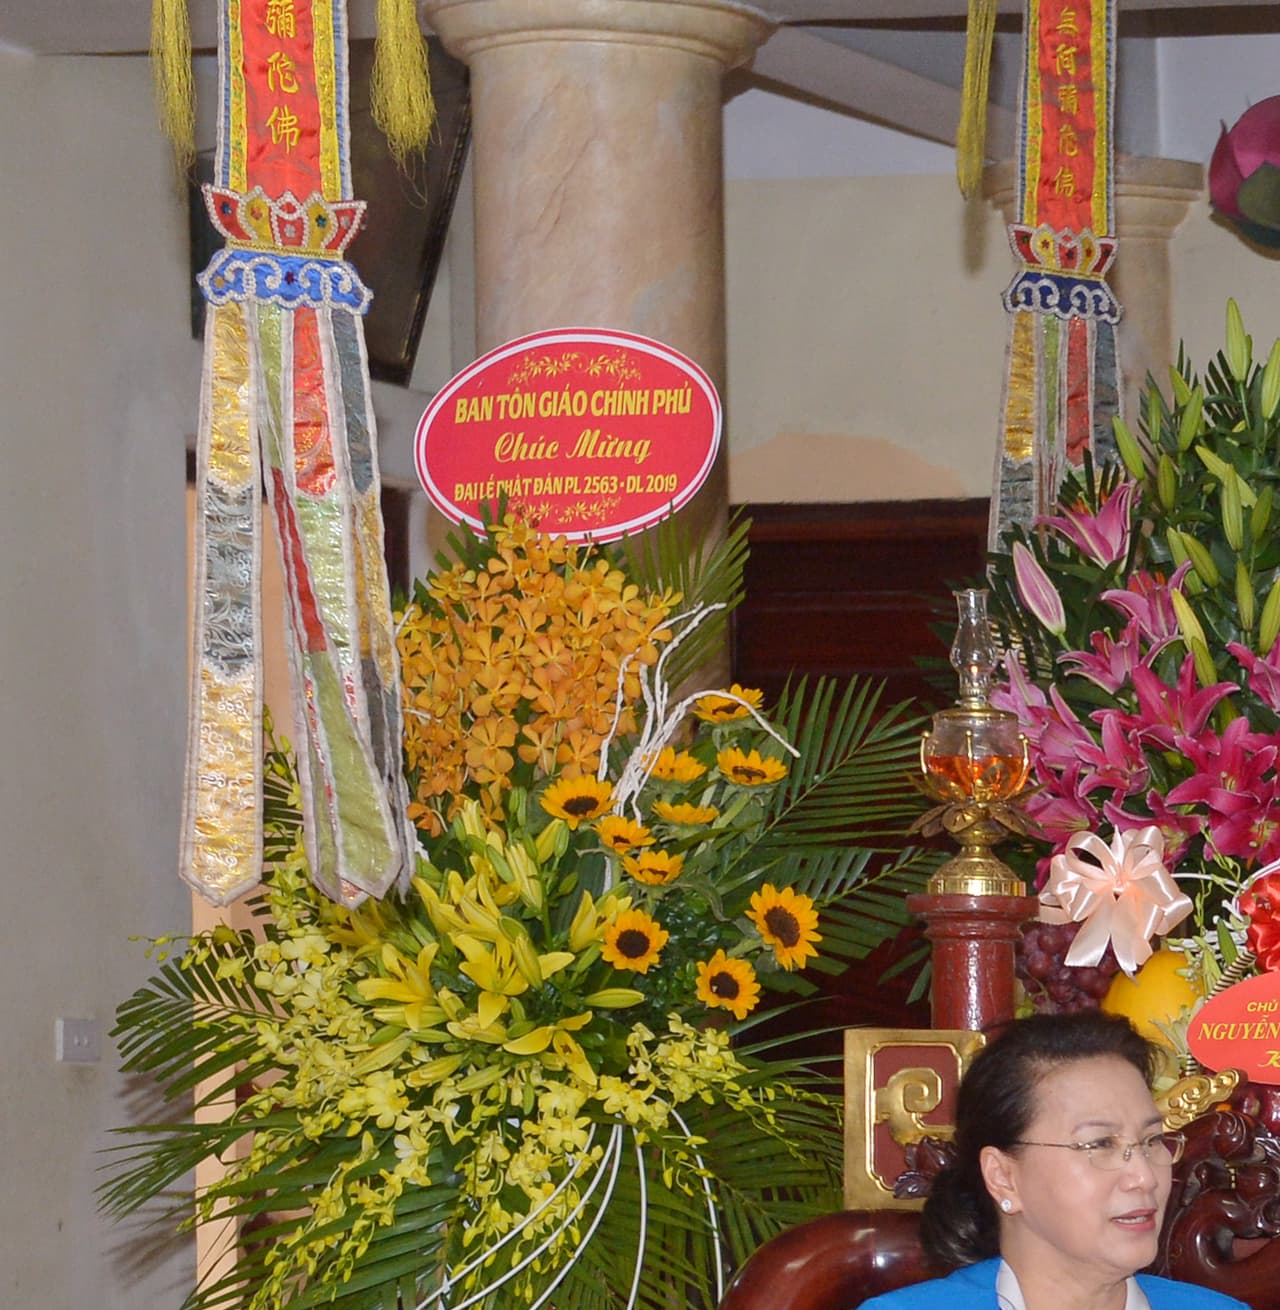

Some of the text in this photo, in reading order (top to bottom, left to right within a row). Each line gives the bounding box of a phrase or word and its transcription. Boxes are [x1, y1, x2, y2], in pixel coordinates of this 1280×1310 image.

[454, 380, 693, 424] BAN TÔN GIÁO CHÍNH PHỦ
[494, 428, 652, 465] Chúc Mừng
[454, 481, 479, 505] ĐẠI
[564, 476, 582, 495] PL
[583, 475, 619, 494] 2563
[626, 475, 645, 494] DL
[646, 473, 678, 493] 2019
[1247, 999, 1279, 1013] CHỦ
